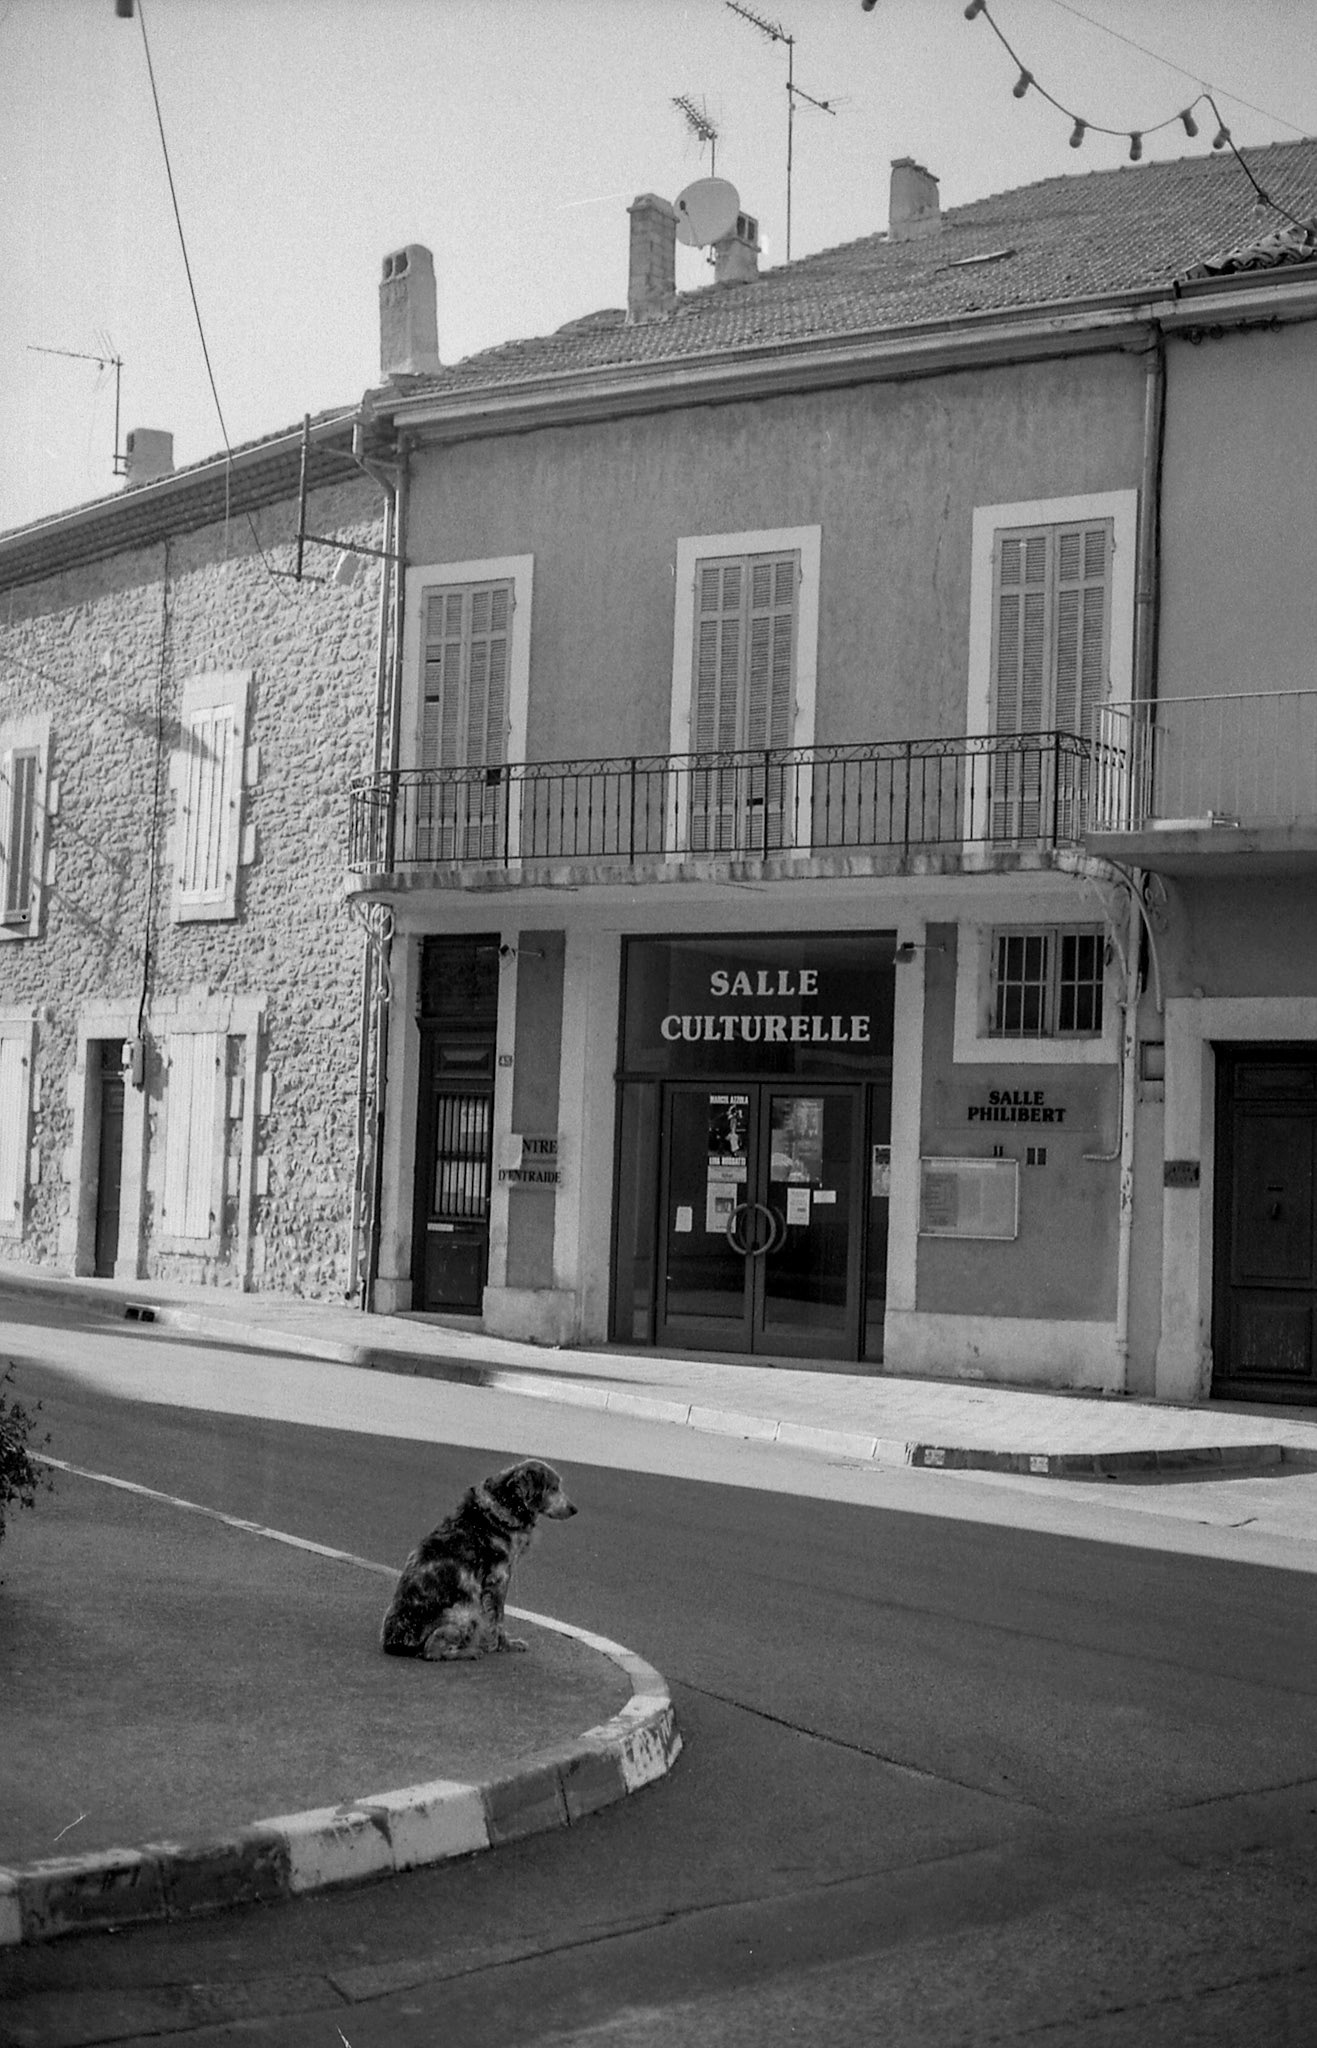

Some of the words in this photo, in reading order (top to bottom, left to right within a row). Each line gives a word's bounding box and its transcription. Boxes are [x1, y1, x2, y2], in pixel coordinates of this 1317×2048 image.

[710, 970, 818, 996] SALLE
[661, 1015, 870, 1041] CULTURELLE
[989, 1091, 1044, 1105] SALLE
[968, 1107, 1066, 1122] PHILIBERT
[522, 1138, 557, 1154] NTRE
[499, 1169, 561, 1183] D'ENTRAIDE
